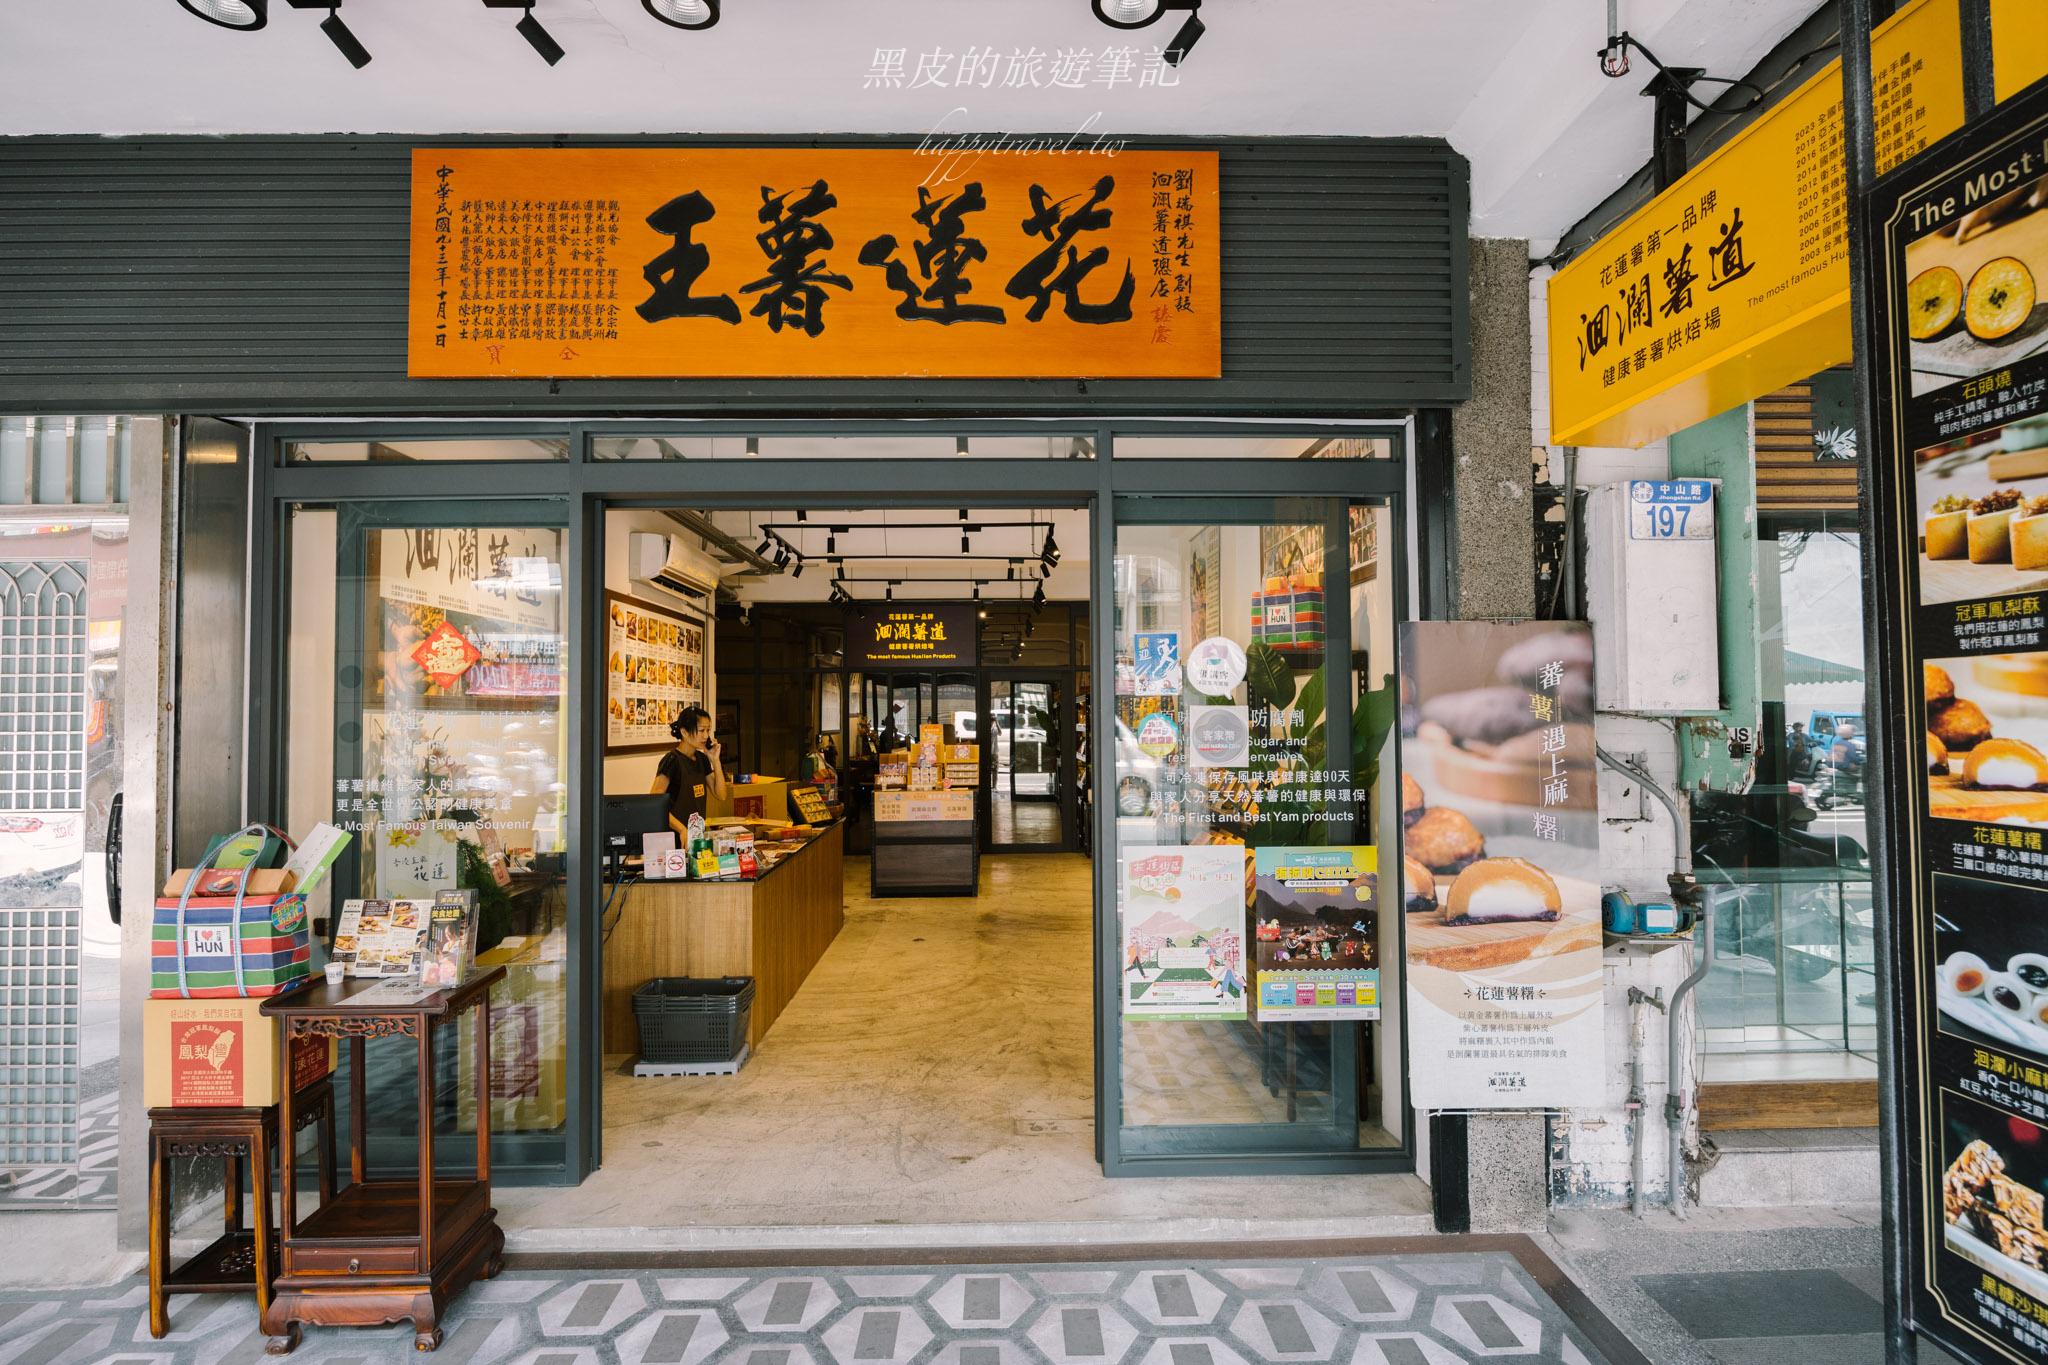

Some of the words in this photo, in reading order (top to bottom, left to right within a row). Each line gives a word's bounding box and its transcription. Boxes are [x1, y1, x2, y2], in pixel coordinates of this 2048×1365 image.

[1795, 122, 1815, 141] 2023
[1795, 135, 1816, 155] 2019
[1796, 149, 1817, 169] 2016
[1797, 164, 1817, 182] 2014
[1798, 192, 1819, 210] 2010
[1909, 196, 1956, 232] The
[1964, 152, 2033, 206] Most
[1798, 205, 1819, 223] 2007
[1799, 220, 1820, 237] 2006
[1600, 189, 1717, 288] 花蓮薯第一品牌
[1799, 234, 1820, 251] 2004
[1800, 248, 1821, 265] 2003
[1747, 294, 1764, 308] The
[1766, 280, 1789, 299] most
[1791, 260, 1828, 285] famous
[1602, 306, 1721, 389] 健康蕃薯烘焙場
[1962, 369, 2012, 400] 石頭燒
[1659, 483, 1702, 495] 中山路
[1647, 505, 1691, 537] 197
[1955, 596, 2041, 622] 冠軍鳳梨酥
[1270, 615, 1286, 623] HUN
[1250, 709, 1305, 728] 防腐劑
[1285, 736, 1308, 746] and
[1730, 727, 1749, 742] JS
[345, 820, 376, 831] Most
[378, 820, 427, 831] Famous
[475, 819, 531, 830] Souvenir
[1163, 813, 1185, 823] The
[1189, 813, 1216, 823] First
[1218, 812, 1241, 823] and
[1244, 812, 1271, 824] Best
[1273, 812, 1299, 823] Yam
[1302, 811, 1354, 825] products
[1973, 825, 2042, 850] 花蓮薯糬
[195, 942, 224, 953] HUN
[1475, 986, 1535, 1001] 花蓮薯糬
